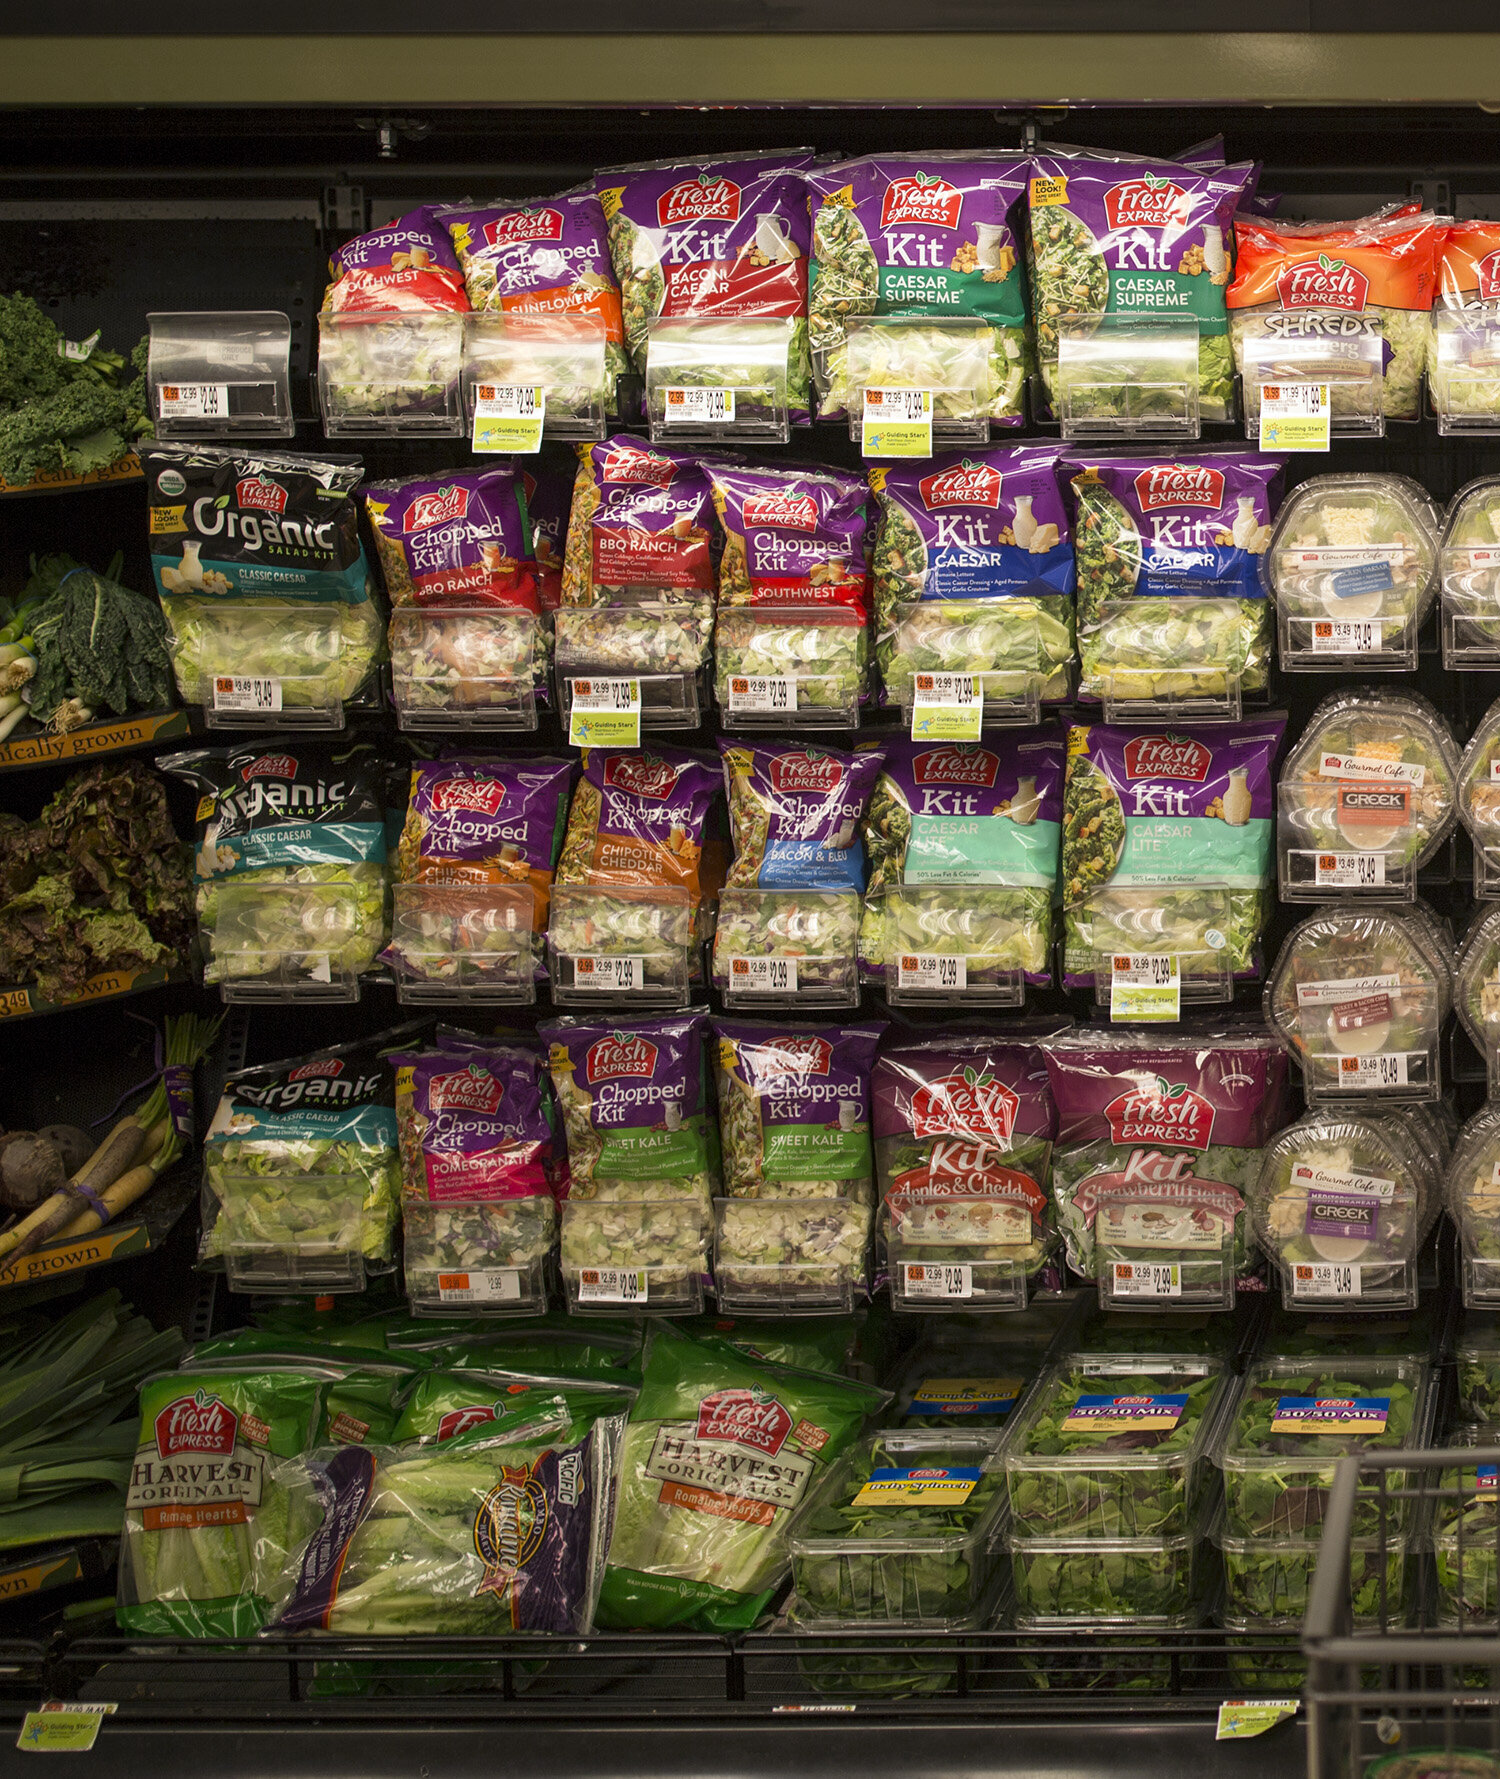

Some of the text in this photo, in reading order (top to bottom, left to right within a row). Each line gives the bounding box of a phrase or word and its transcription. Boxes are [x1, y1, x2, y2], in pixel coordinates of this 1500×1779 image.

[670, 178, 727, 206] Fresh
[1035, 185, 1062, 194] LOOK!
[667, 200, 728, 220] EXPRESS
[502, 240, 600, 270] Chopped
[668, 231, 726, 263] Kit
[1116, 236, 1170, 270] Kit
[340, 271, 419, 294] SOUTHWEST
[671, 270, 721, 285] BACON
[885, 275, 947, 288] CAESAR
[1290, 269, 1356, 293] Fresh
[671, 282, 728, 297] CAESAR
[885, 288, 960, 303] SUPREME
[1290, 291, 1356, 306] EXPRESS
[511, 293, 592, 313] SUNFLOWER
[1265, 311, 1376, 339] SHREDS
[707, 392, 724, 418] $2.99
[905, 392, 922, 419] $2.99
[932, 467, 992, 488] Fresh
[241, 485, 281, 501] Fresh
[931, 488, 992, 503] EXPRESS
[242, 498, 281, 510] EXPRESS
[193, 497, 335, 551] Organic
[268, 544, 335, 560] SALAD KIT
[600, 539, 677, 553] BBQ RANCH
[754, 532, 853, 554] Chopped
[413, 549, 445, 570] Kit
[754, 553, 787, 572] Kit
[935, 553, 1001, 568] CAESAR
[1322, 551, 1383, 563] Gourmet Cafe
[239, 569, 306, 584] CLASSIC CAESAR
[758, 587, 836, 598] SOUTHWEST
[1354, 624, 1372, 650] $3.49
[254, 680, 272, 707] $3.49
[73, 727, 143, 756] grown
[1135, 739, 1199, 762] Fresh
[1135, 762, 1199, 777] EXPRESS
[1346, 793, 1401, 806] GREEK
[241, 829, 312, 847] CLASSIC CAESAR
[1132, 838, 1161, 852] LITE
[602, 844, 663, 862] CHIPOTLE
[771, 850, 848, 862] BACON & BLEU
[600, 856, 663, 874] CHEDDAR
[615, 961, 633, 986] $2.99
[599, 1077, 686, 1105] Chopped
[597, 1105, 626, 1124] Kit
[1122, 1098, 1199, 1127] Fresh
[771, 1134, 844, 1147] SWEET KALE
[432, 1155, 532, 1174] POMEGRANATE
[1124, 1149, 1192, 1182] Kit
[712, 1395, 779, 1432] Fresh
[1074, 1404, 1176, 1418] 50/50 Mix
[658, 1435, 804, 1488] HARVEST
[132, 1461, 256, 1488] HARVEST
[560, 1456, 576, 1502] PACIFIC
[870, 1480, 970, 1493] Baby Spinach
[674, 1488, 762, 1519] Romaine Hearts
[196, 1507, 239, 1522] Hearts
[533, 1495, 545, 1534] JUMBO
